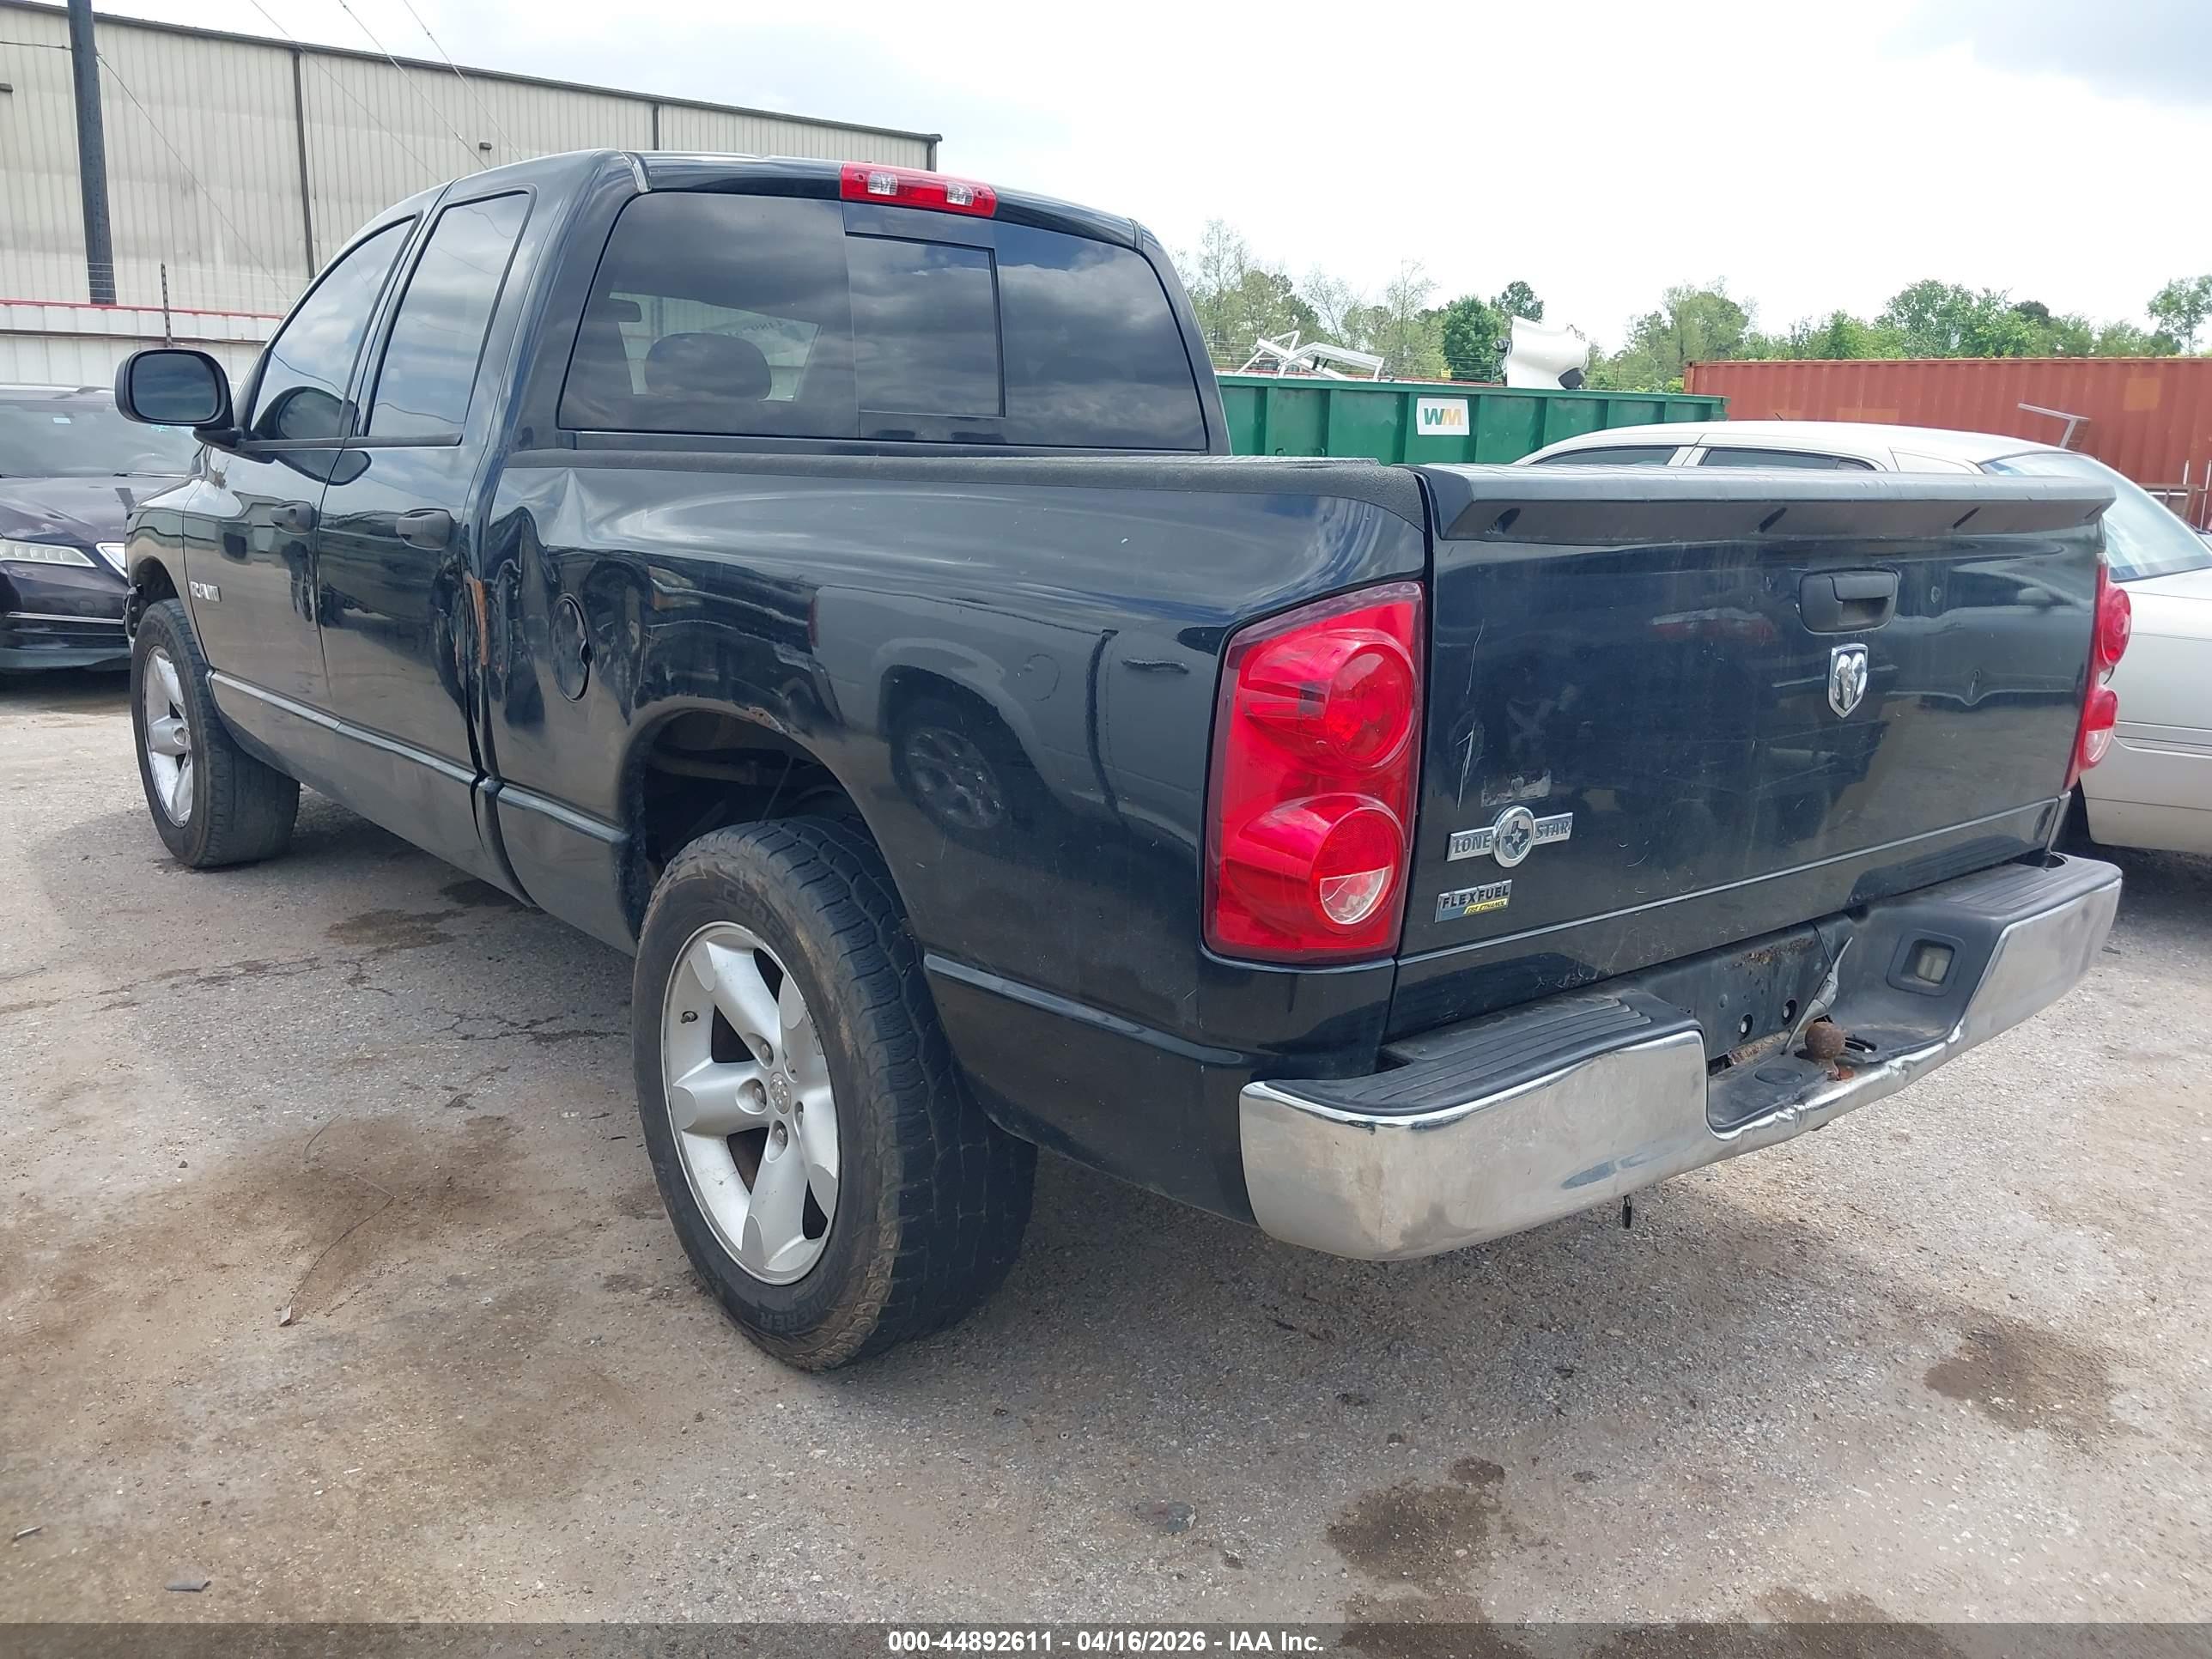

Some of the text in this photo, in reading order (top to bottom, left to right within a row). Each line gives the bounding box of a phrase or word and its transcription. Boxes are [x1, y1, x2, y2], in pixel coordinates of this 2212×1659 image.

[1424, 408, 1462, 425] WM
[190, 581, 220, 601] RAM
[1454, 821, 1571, 854] LONE STAR
[1442, 885, 1509, 908] FLEXFUEL
